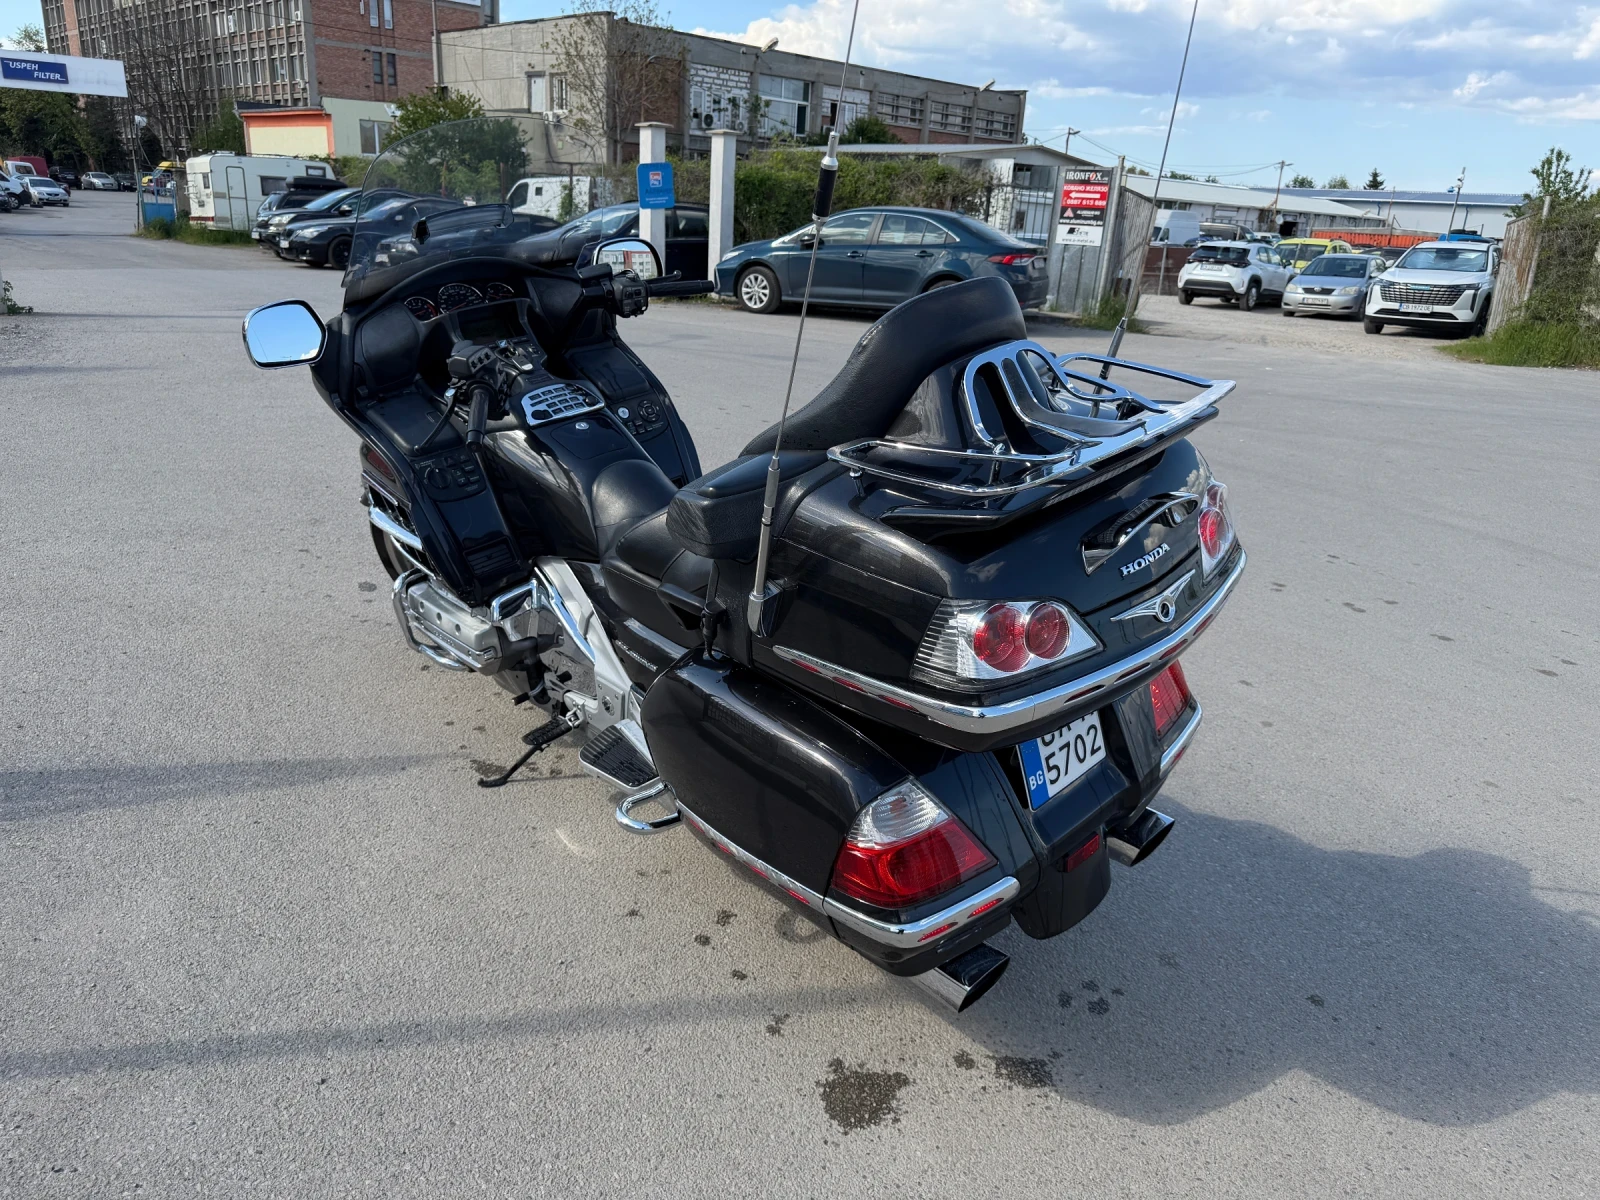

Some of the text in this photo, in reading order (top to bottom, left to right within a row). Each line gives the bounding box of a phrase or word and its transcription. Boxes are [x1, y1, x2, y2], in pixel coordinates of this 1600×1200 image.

[9, 61, 39, 70] USPEH
[34, 72, 61, 80] FILTER
[1119, 542, 1171, 577] HONDA
[1044, 723, 1102, 786] 5702
[1028, 769, 1045, 791] BG
